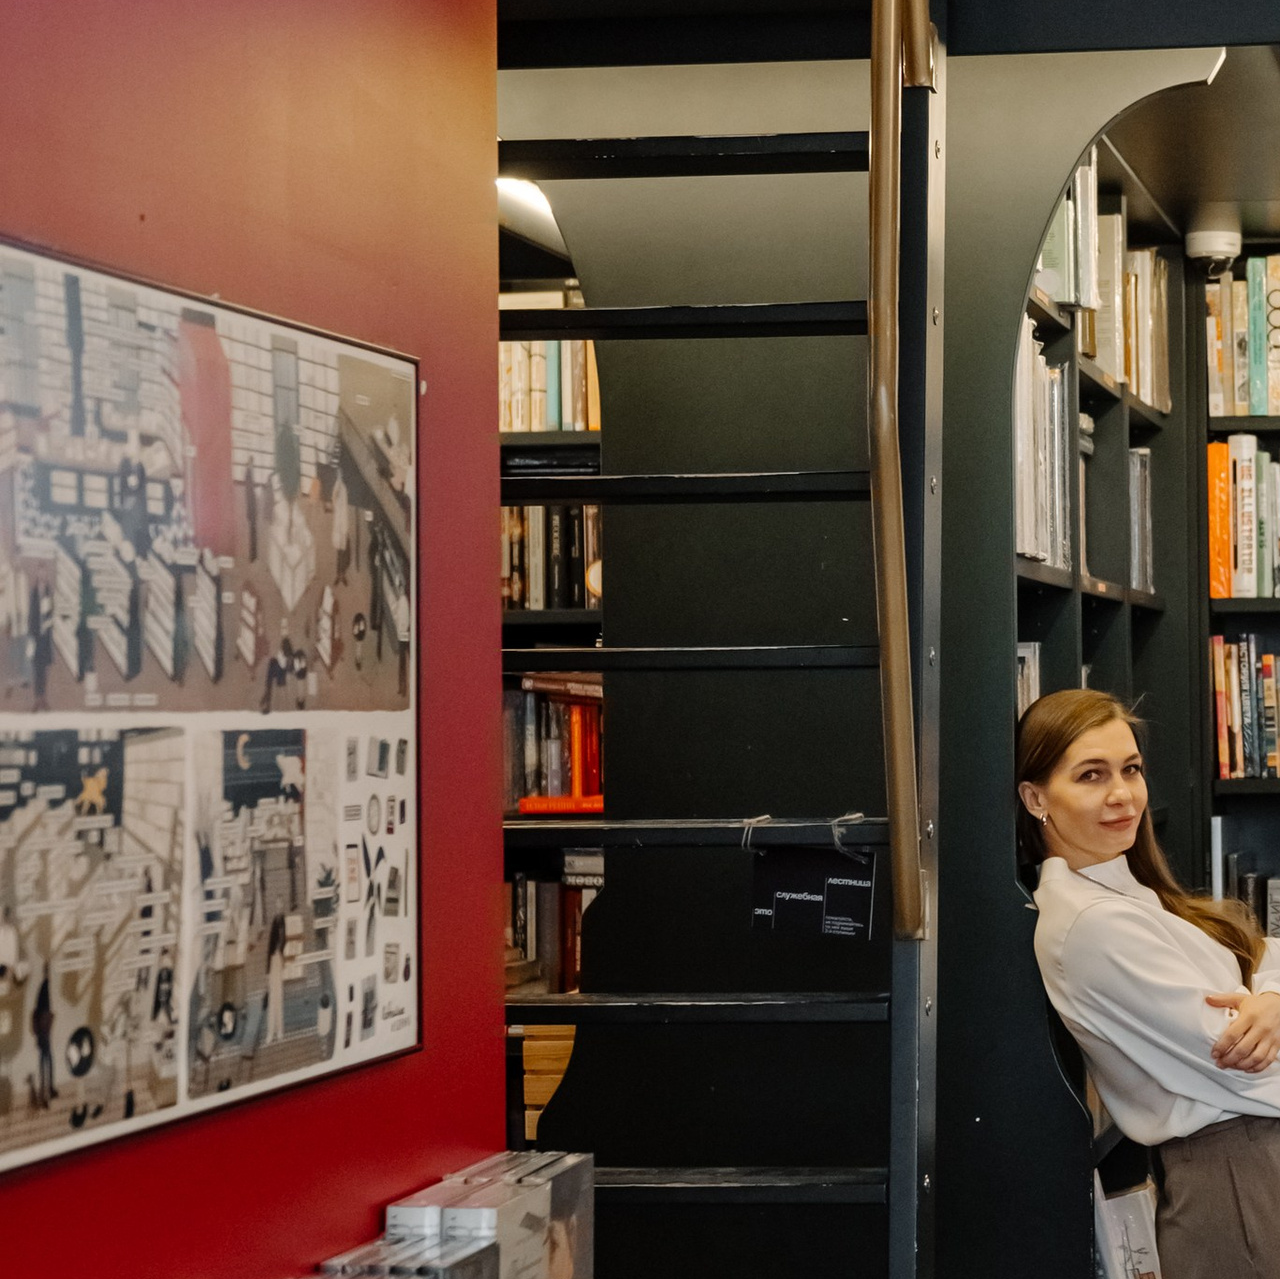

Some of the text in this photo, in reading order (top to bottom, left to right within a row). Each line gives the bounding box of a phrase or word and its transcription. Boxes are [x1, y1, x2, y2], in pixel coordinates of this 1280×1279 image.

[1241, 487, 1253, 574] ILLUSTRATOR
[827, 877, 872, 888] лестница
[775, 891, 824, 902] служебная
[754, 908, 773, 916] это
